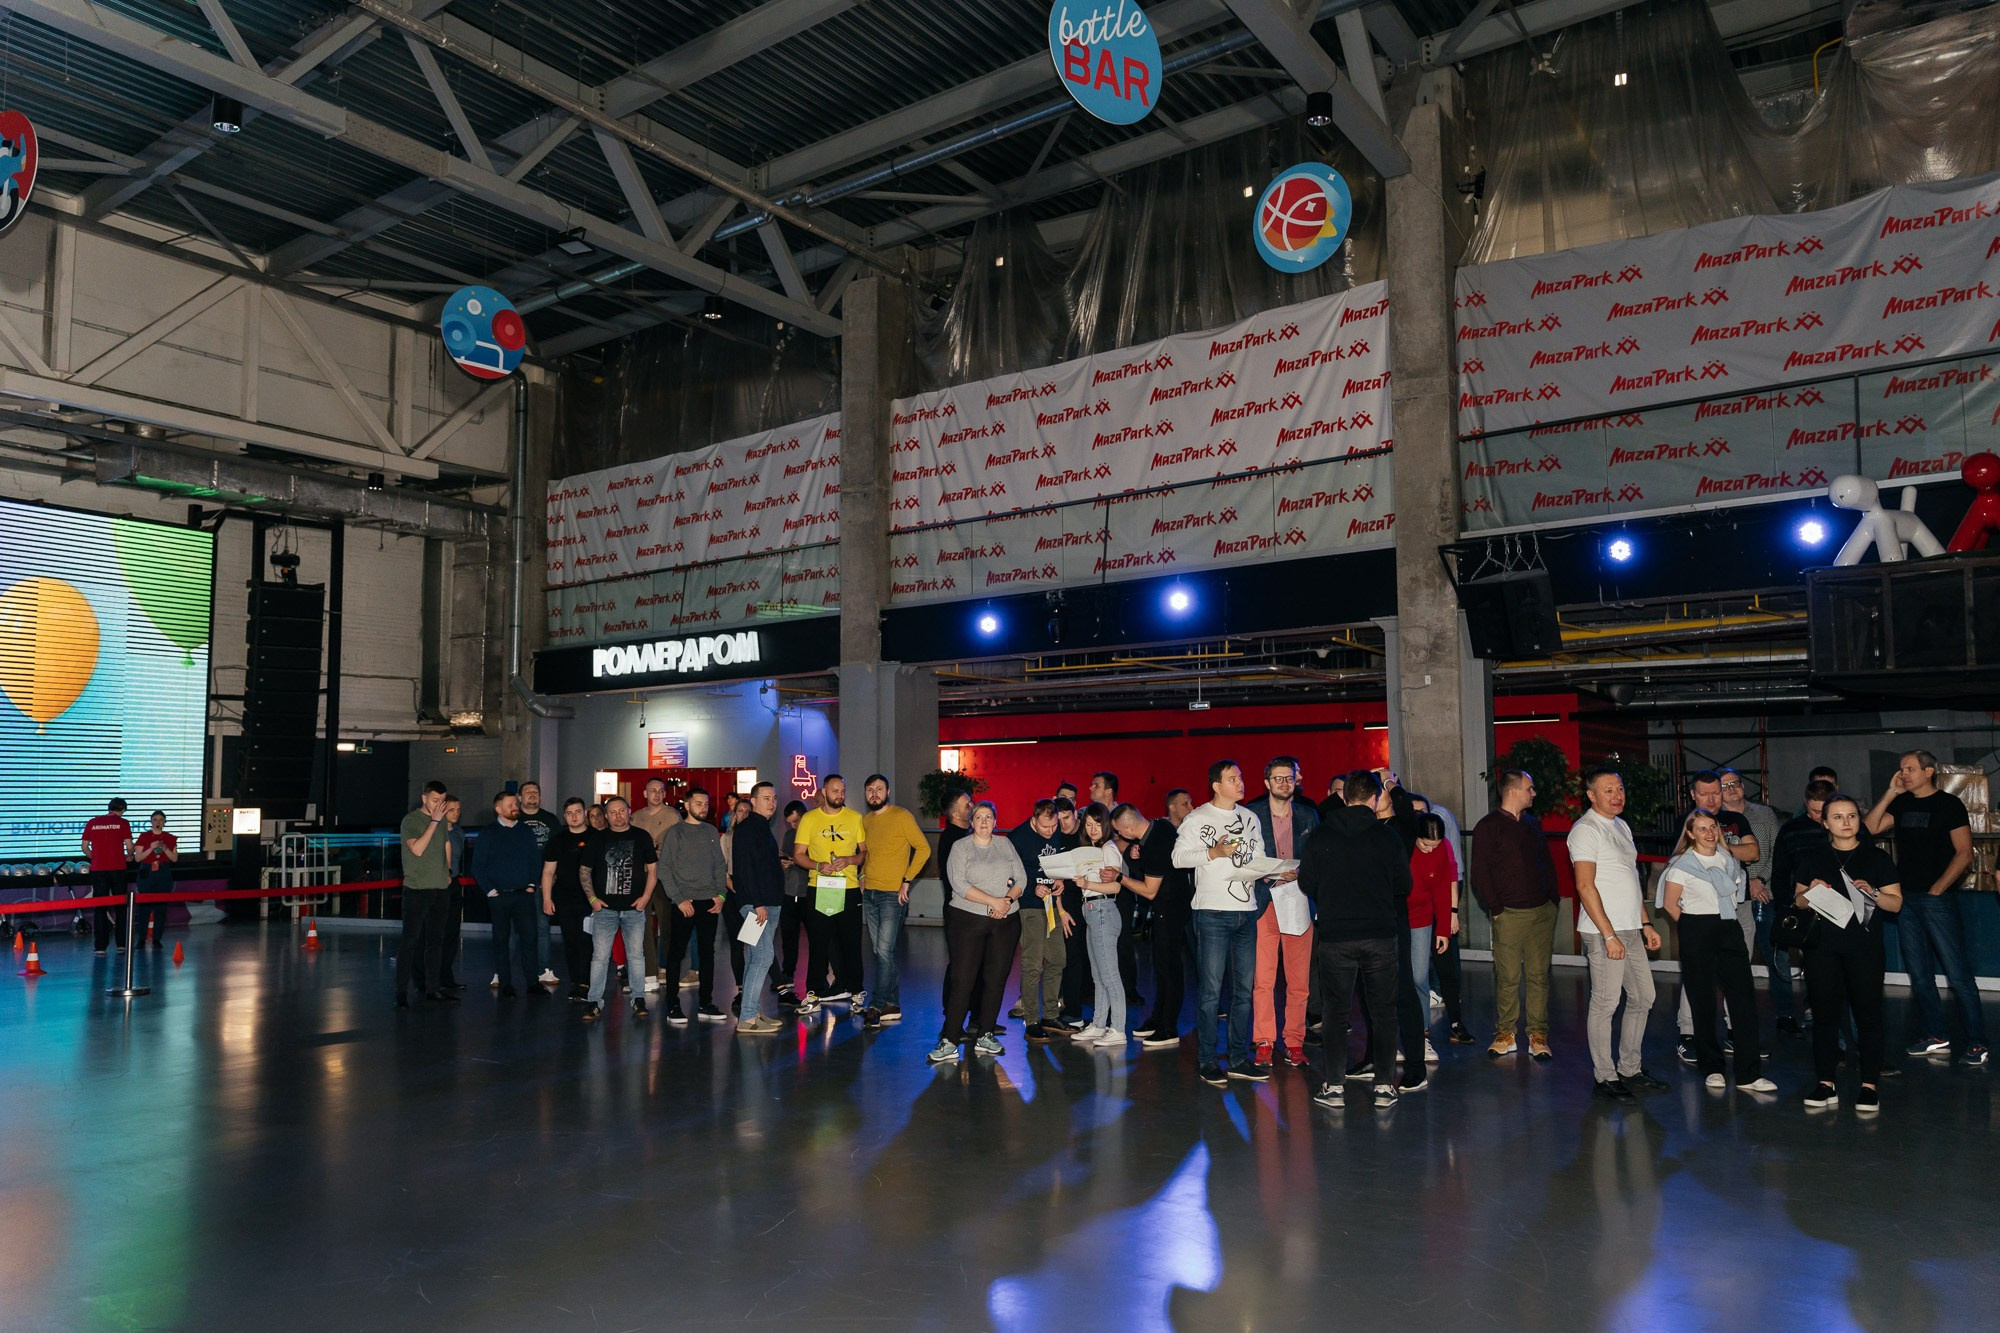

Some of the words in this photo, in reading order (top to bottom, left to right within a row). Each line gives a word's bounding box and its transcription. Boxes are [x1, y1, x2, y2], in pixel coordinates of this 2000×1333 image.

[1059, 6, 1146, 46] bottle
[1064, 38, 1150, 107] BAR
[1880, 201, 1990, 239] MazaPark
[1694, 240, 1790, 272] MazaPark
[1531, 270, 1614, 299] MazaPark
[1785, 260, 1887, 297] MazaPark
[1340, 298, 1390, 327] MazaP
[1607, 292, 1697, 322] MazaPark
[1882, 281, 1993, 319] MazaPark
[1209, 326, 1277, 359] MazaPark
[1457, 318, 1535, 343] MazaPark
[1691, 316, 1789, 345] MazaPark
[1273, 345, 1346, 378] MazaPark
[1530, 341, 1613, 369] MazaPark
[1783, 339, 1887, 371] MazaPark
[1092, 358, 1152, 387] MazaPark
[1342, 371, 1392, 399] MazaP
[1609, 364, 1697, 394] MazaPark
[1884, 363, 1996, 399] MazaPark
[986, 385, 1040, 410] MazaPark
[1150, 376, 1213, 405] MazaPark
[1459, 386, 1534, 411] MazaPark
[893, 406, 940, 427] MazaPark
[1037, 404, 1092, 429] MazaPark
[1211, 397, 1278, 427] MazaPark
[1695, 393, 1790, 422] MazaPark
[938, 424, 989, 447] MazaPark
[1092, 423, 1153, 450] MazaPark
[1276, 415, 1348, 447] MazaPark
[1786, 418, 1890, 450] MazaPark
[745, 441, 786, 462] MazaPark
[985, 444, 1040, 470] MazaPark
[1151, 443, 1214, 470] MazaPark
[1609, 441, 1699, 467] MazaPark
[674, 459, 710, 478] MazaPark
[783, 458, 826, 479] MazaPark
[892, 464, 940, 484] MazaPark
[1465, 456, 1534, 481] MazaPark
[1888, 451, 1962, 479] MazaP
[607, 476, 641, 491] MazaPark
[708, 478, 747, 495] MazaPark
[1035, 467, 1092, 491] MazaPark
[1695, 472, 1793, 498] MazaPark
[636, 494, 674, 509] MazaPark
[744, 496, 786, 515] MazaPark
[938, 484, 990, 505] MazaPark
[1277, 489, 1350, 517] MazaPark
[1531, 486, 1614, 512] MazaPark
[576, 506, 608, 519] MazaPark
[673, 511, 710, 529] MazaPark
[783, 514, 825, 533] MazaPark
[1152, 510, 1216, 536] MazaPark
[605, 526, 638, 540] MazaPark
[708, 529, 747, 547] MazaPark
[1347, 513, 1396, 539] MazaP
[636, 544, 673, 559] MazaPark
[937, 544, 989, 565] MazaPark
[1035, 532, 1092, 554] MazaPark
[1213, 532, 1281, 559] MazaPark
[574, 555, 608, 568] MazaPark
[1094, 549, 1155, 575] MazaPark
[782, 568, 824, 586] MazaPark
[892, 577, 940, 595] MazaPark
[986, 565, 1040, 587] MazaPark
[635, 593, 673, 609] MazaPark
[706, 582, 745, 598] MazaPark
[573, 603, 608, 616] MazaPark
[670, 610, 708, 625] MazaPark
[604, 619, 638, 634] MazaPark
[593, 631, 760, 677] РОЛЛЕРДРОМ
